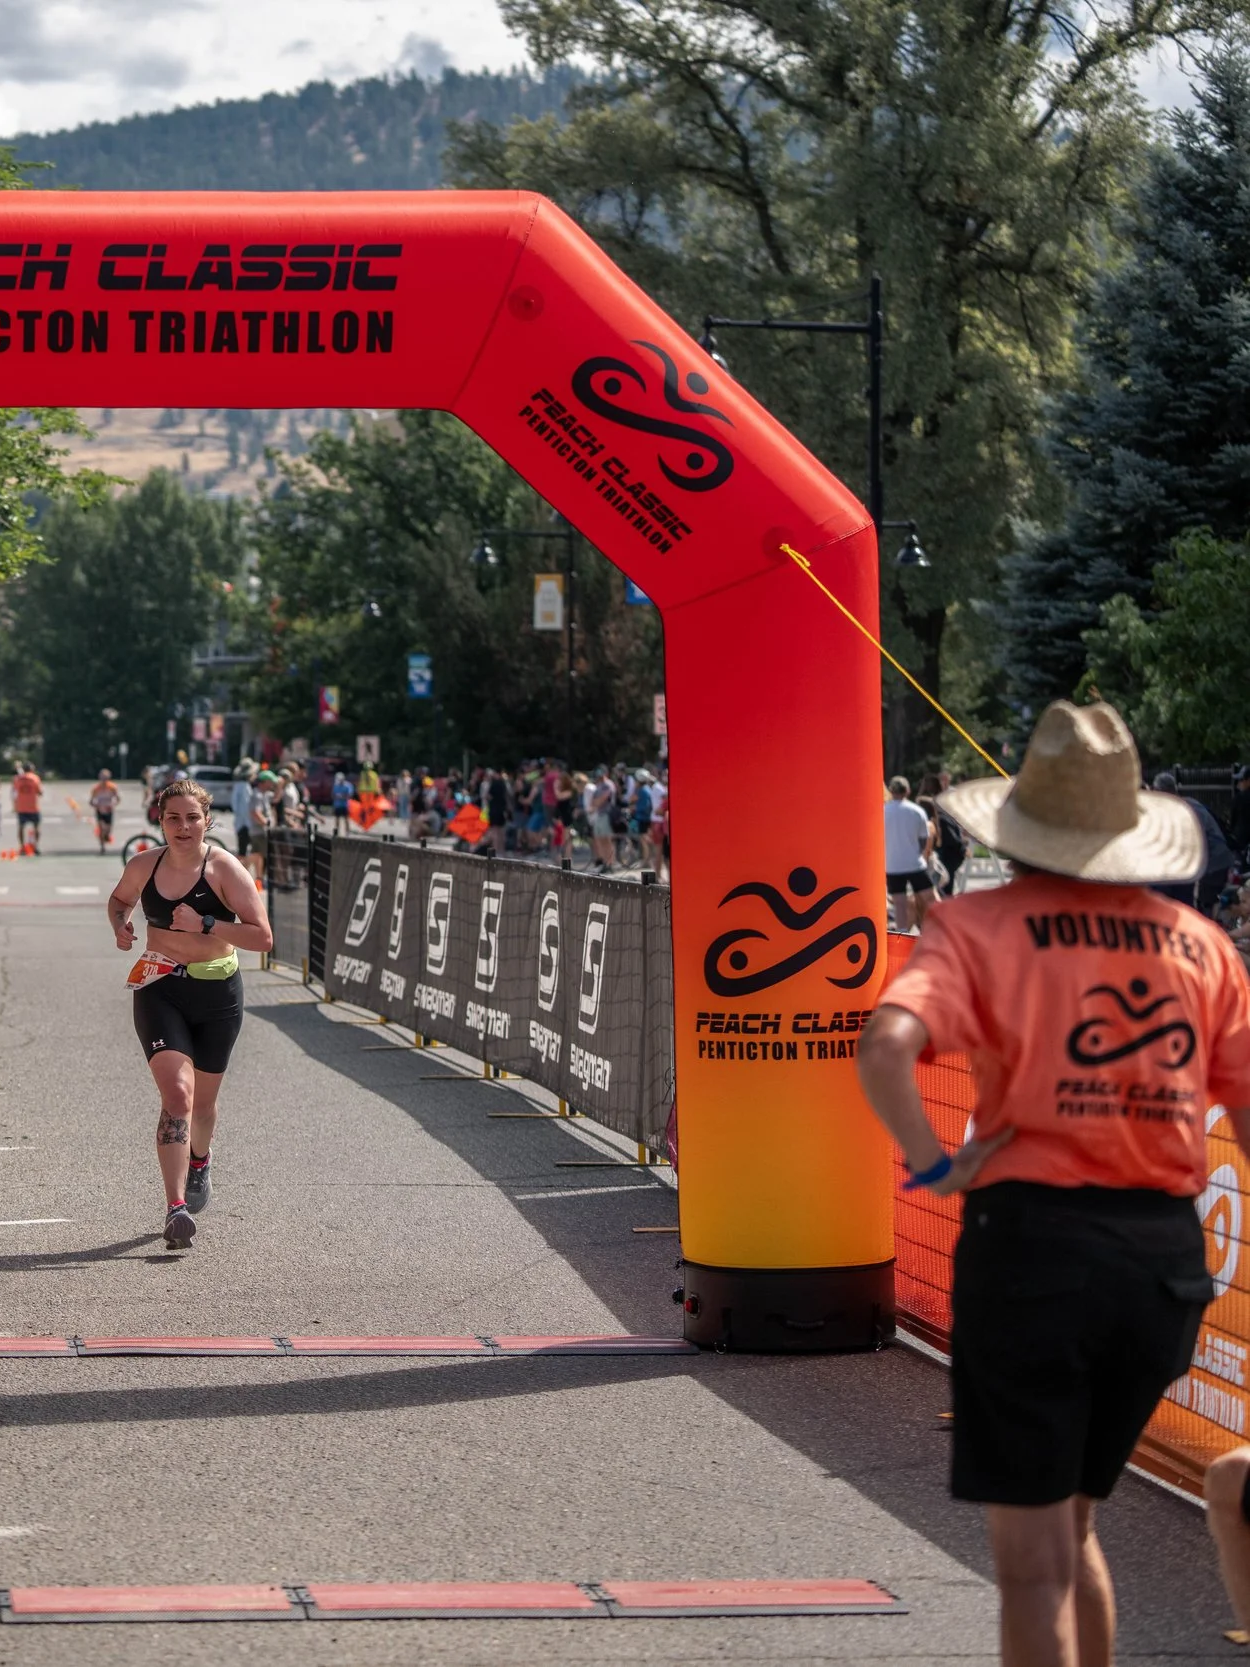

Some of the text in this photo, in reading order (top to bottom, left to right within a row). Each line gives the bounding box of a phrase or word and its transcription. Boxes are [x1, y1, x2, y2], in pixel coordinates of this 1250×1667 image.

[97, 243, 404, 292] CLASSIC
[128, 310, 394, 355] TRIATHLON
[518, 405, 673, 555] PENTICTON TRIATHLON
[531, 388, 694, 542] PEACH CLASSIC
[413, 982, 456, 1020] swagman
[465, 1000, 509, 1041] swagman
[695, 1009, 876, 1035] PEACH CLASS
[698, 1038, 859, 1061] PENTICTON TRIAT
[1191, 1333, 1247, 1387] LASSIC
